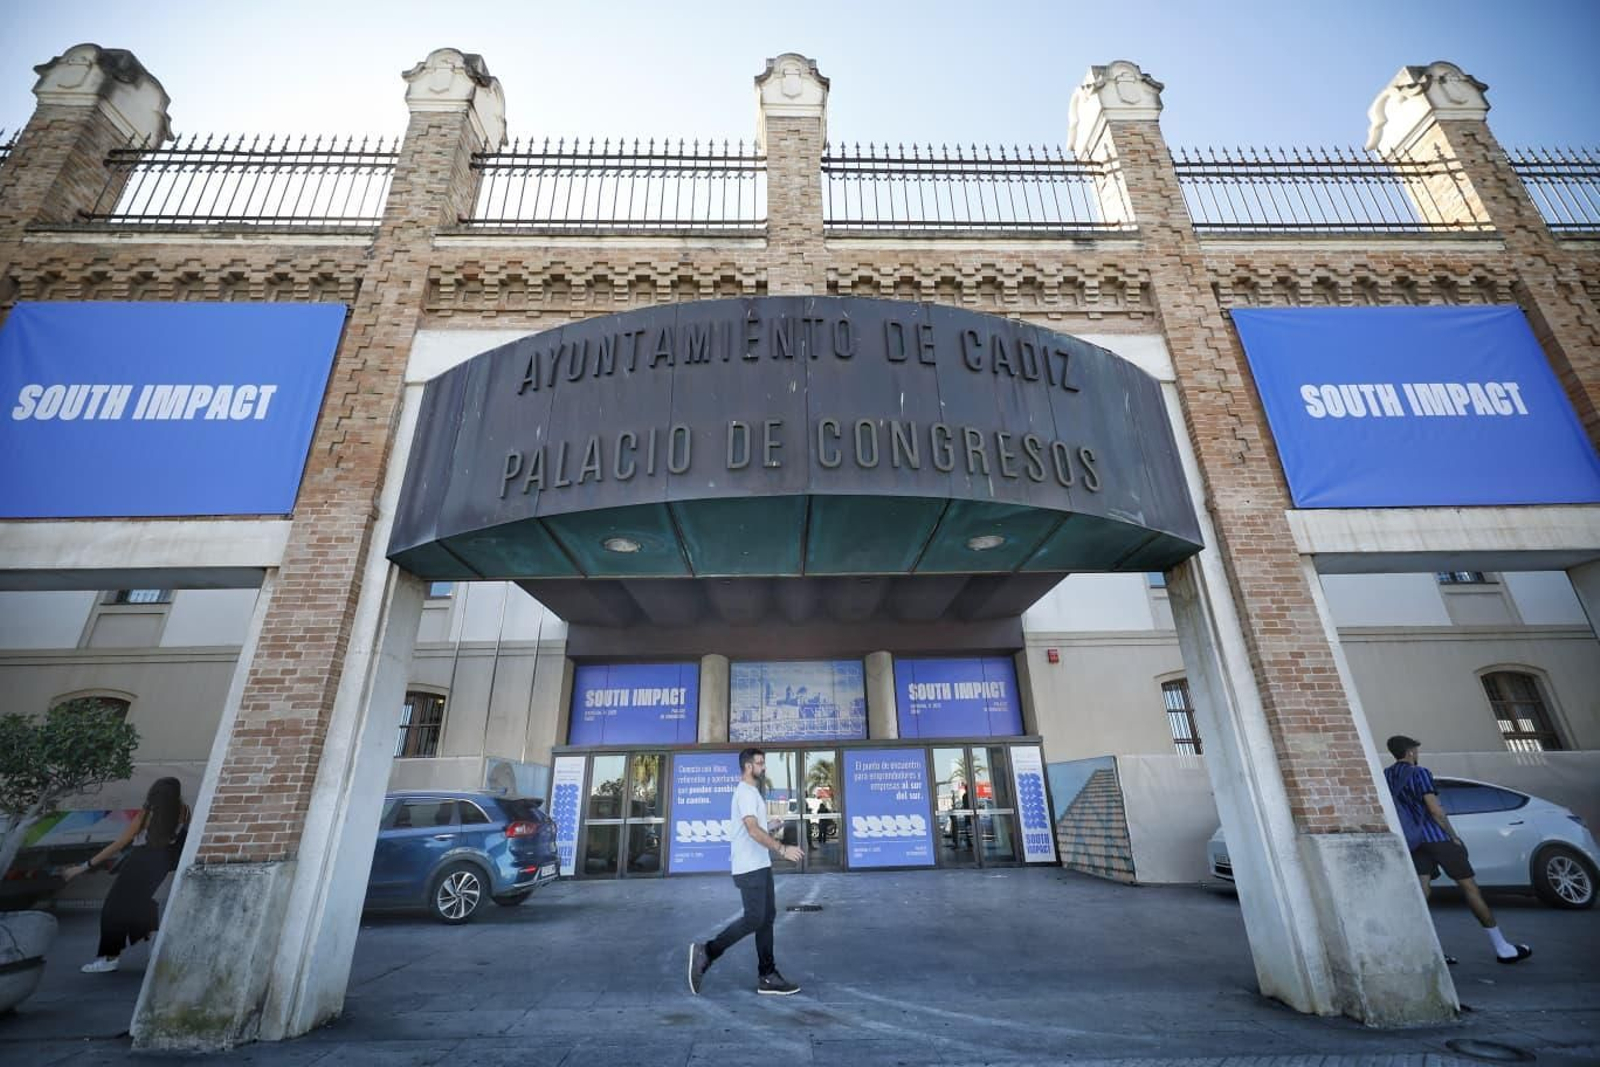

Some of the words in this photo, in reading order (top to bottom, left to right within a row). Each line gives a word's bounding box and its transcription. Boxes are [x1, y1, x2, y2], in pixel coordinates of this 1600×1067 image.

[518, 317, 854, 395] AYUNTAMIENTO
[884, 319, 937, 366] DE
[960, 329, 1080, 394] CADIZ
[12, 384, 133, 421] SOUTH
[132, 384, 278, 421] IMPACT
[1300, 383, 1405, 419] SOUTH
[1402, 382, 1529, 417] IMPACT
[500, 425, 692, 499] PALACIO
[726, 419, 783, 470] DE
[818, 418, 1100, 493] CONGRESOS
[586, 689, 630, 707] SOUTH
[632, 688, 686, 706] IMPACT
[909, 683, 952, 700] SOUTH
[954, 682, 1006, 699] IMPACT
[1026, 834, 1050, 844] SOUTH
